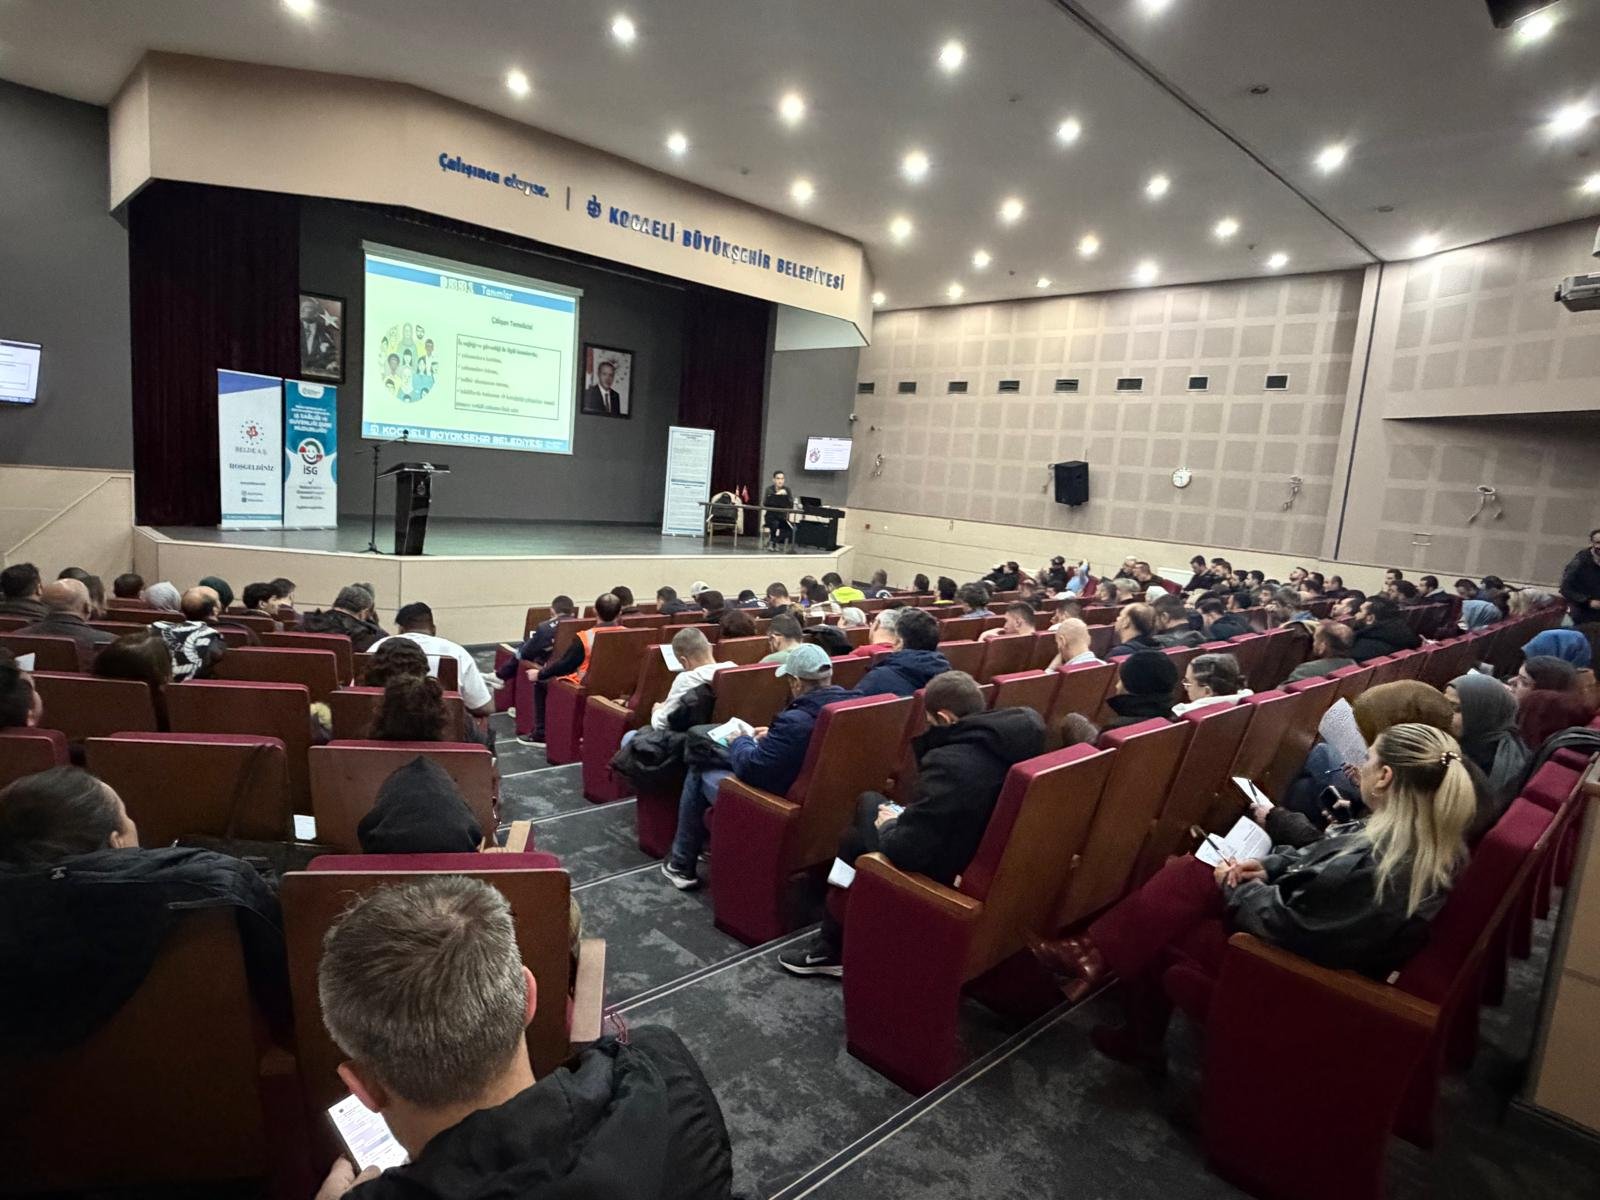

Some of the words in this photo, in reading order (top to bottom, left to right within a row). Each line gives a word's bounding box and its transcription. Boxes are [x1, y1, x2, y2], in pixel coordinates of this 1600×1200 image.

[438, 152, 500, 185] Çalışınca
[608, 206, 676, 243] KOCAELİ
[682, 229, 771, 270] BÜYÜKŞEHİR
[776, 258, 845, 291] BELEDİYESİ
[303, 464, 318, 475] İSG
